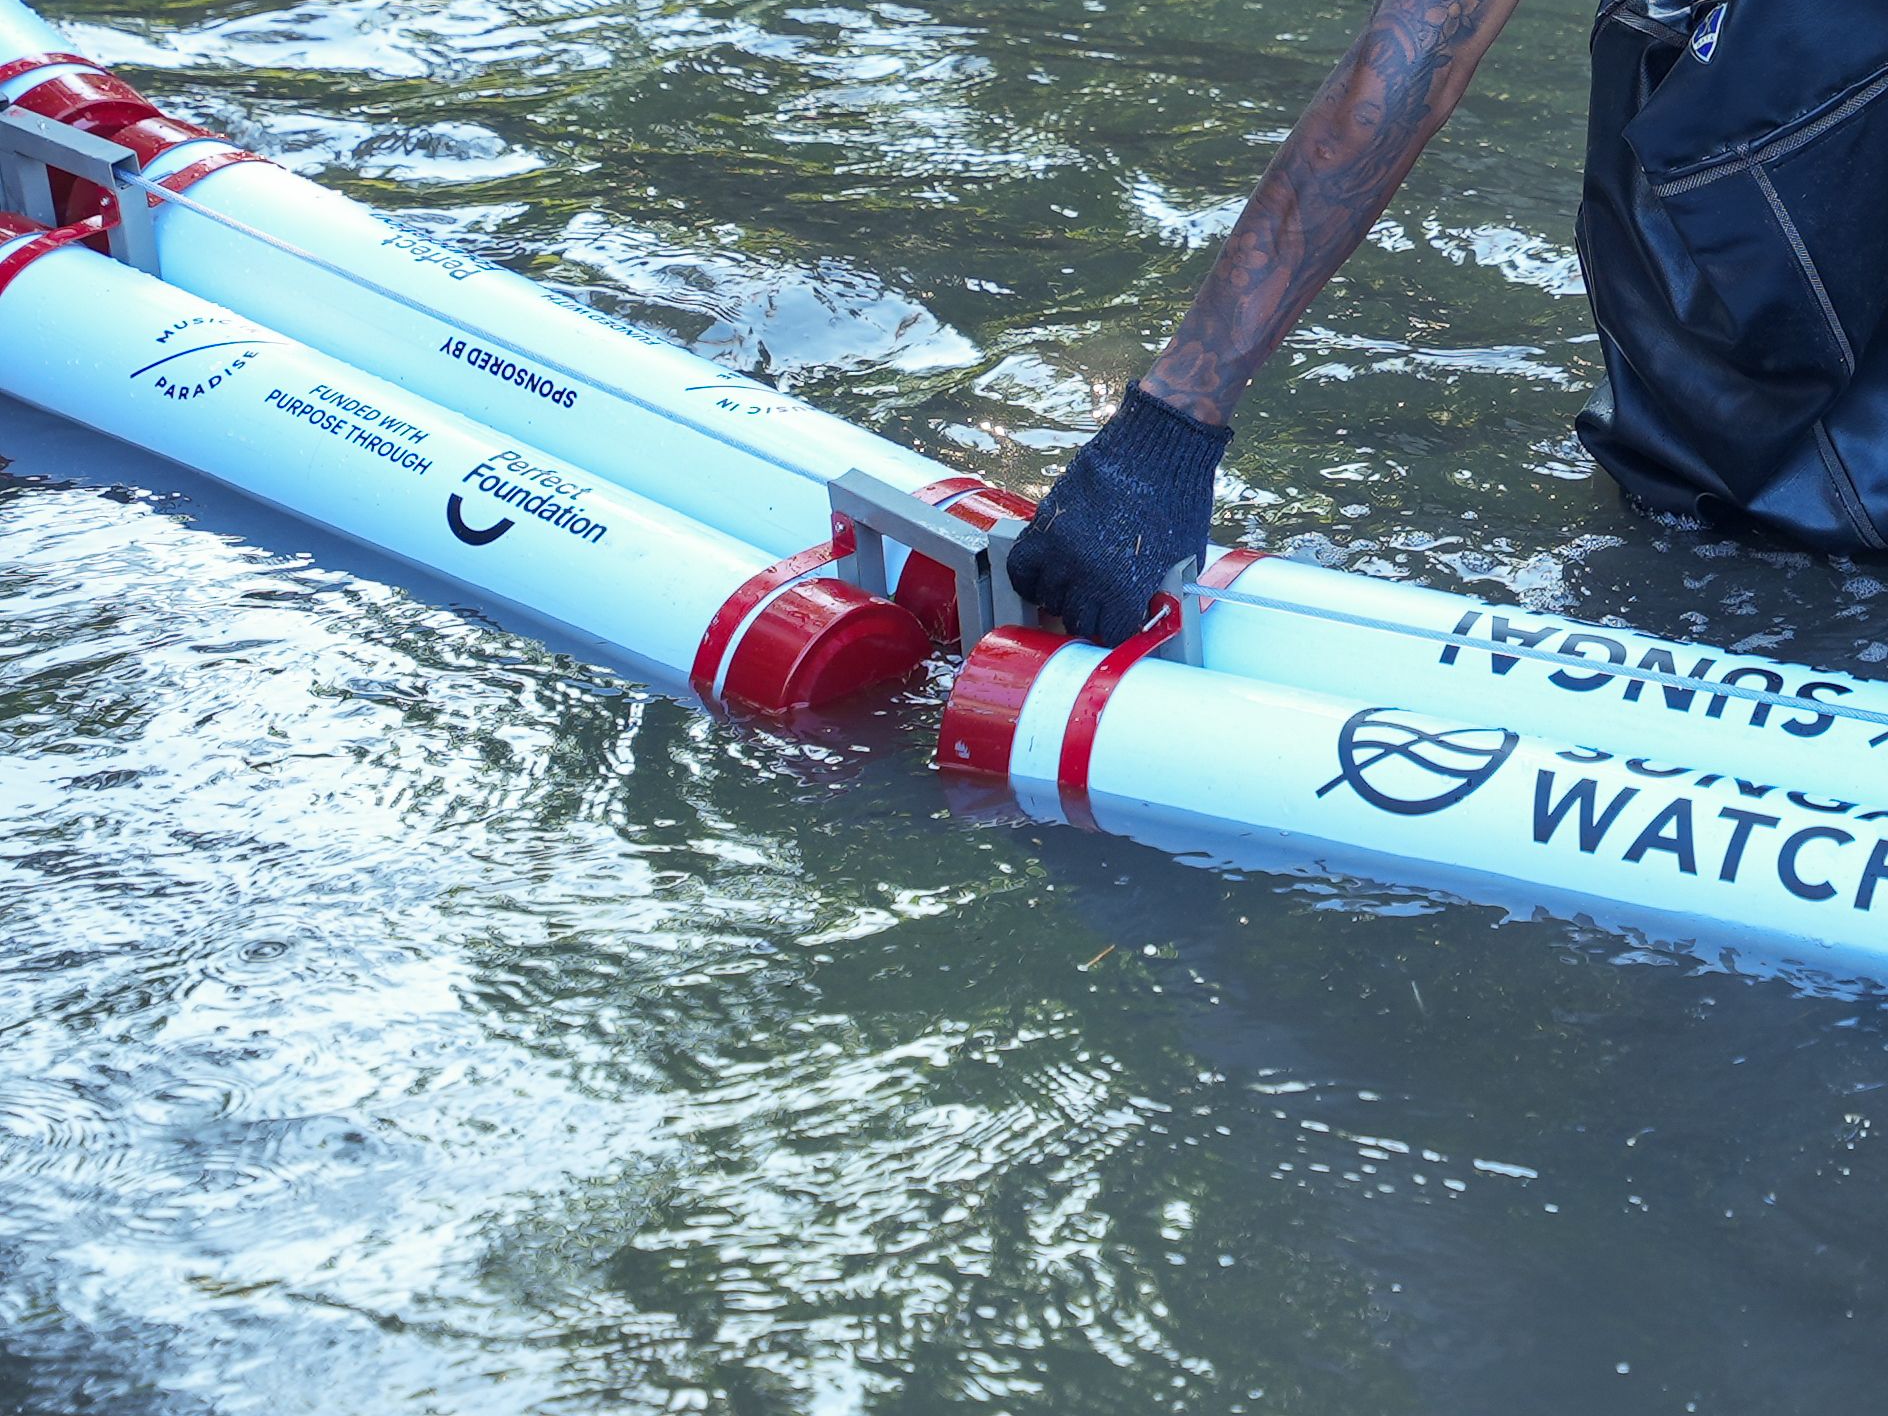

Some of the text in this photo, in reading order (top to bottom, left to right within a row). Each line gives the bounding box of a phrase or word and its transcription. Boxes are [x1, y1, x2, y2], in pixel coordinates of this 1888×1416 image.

[381, 234, 481, 281] Perfect
[156, 317, 232, 343] MUSIC
[154, 350, 259, 399] PARADISE
[439, 336, 577, 408] SPONSORED BY
[264, 388, 433, 475] PURPOSE THROUGH
[308, 384, 430, 444] FUNDED WITH
[462, 463, 608, 543] Foundation
[487, 450, 593, 500] Perfect
[1438, 610, 1854, 739] SUNGAI
